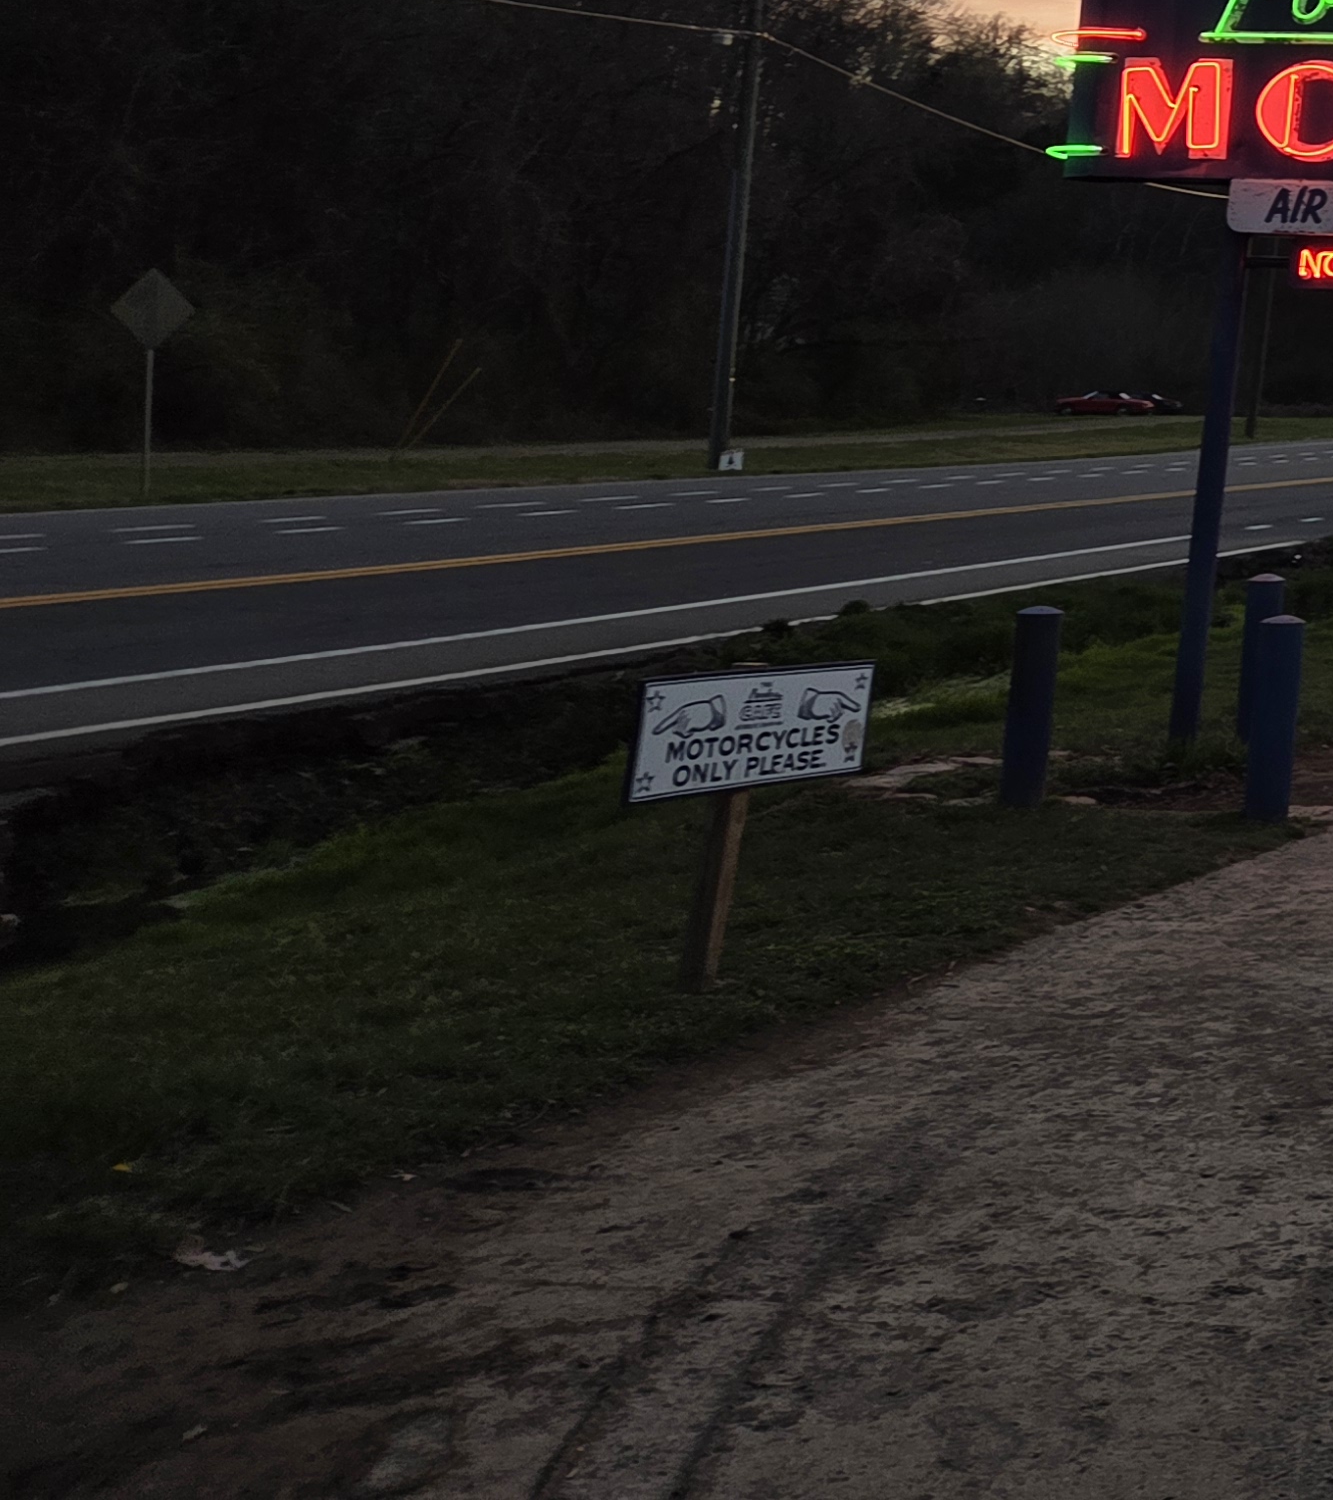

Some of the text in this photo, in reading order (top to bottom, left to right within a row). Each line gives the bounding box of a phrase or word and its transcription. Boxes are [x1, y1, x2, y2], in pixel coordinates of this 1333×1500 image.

[1264, 186, 1328, 224] AIR
[665, 724, 840, 763] MOTORCYCLES
[672, 749, 826, 787] ONLY PLEASE
